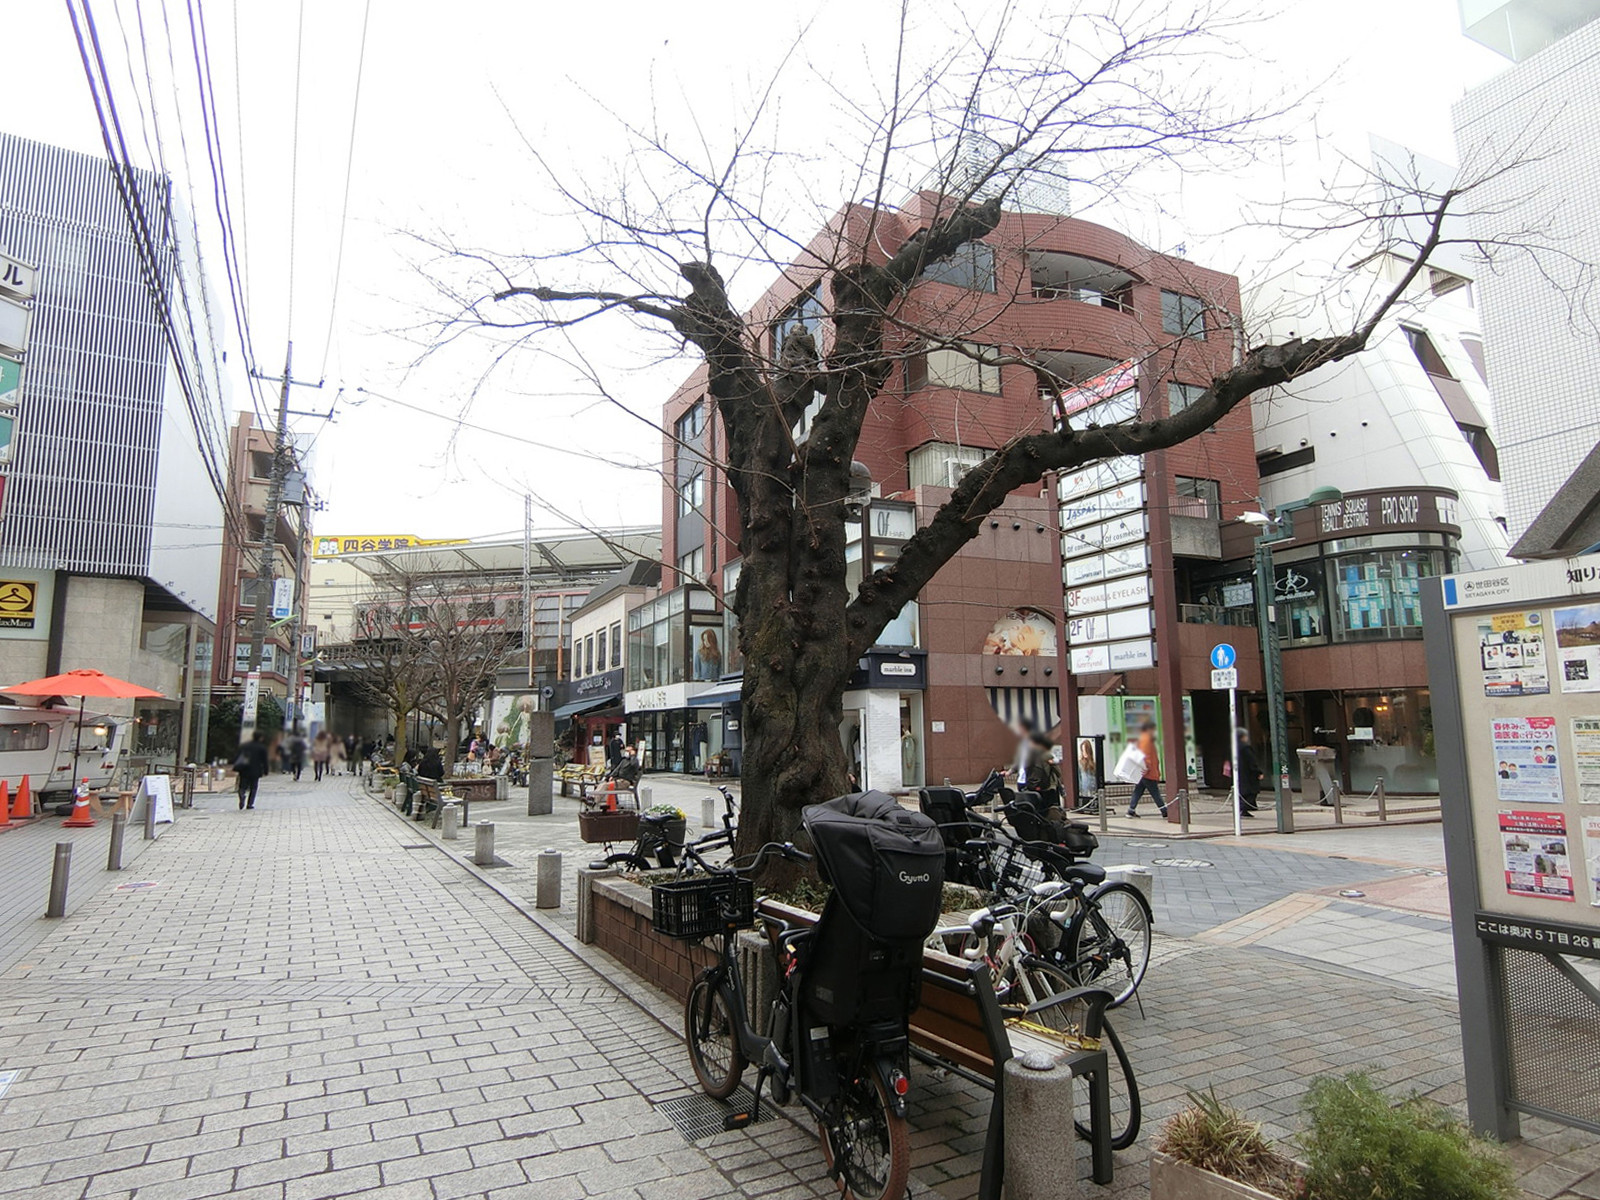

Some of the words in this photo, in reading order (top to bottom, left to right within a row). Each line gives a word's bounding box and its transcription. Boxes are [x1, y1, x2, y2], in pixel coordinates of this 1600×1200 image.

[1066, 504, 1097, 520] JASPAS
[1320, 502, 1342, 518] TENNIS
[1345, 498, 1368, 513] SQUASH
[1382, 498, 1398, 524] PRO
[1400, 496, 1418, 523] SHOP
[1113, 528, 1142, 541] cosmetics
[343, 538, 410, 551] 四谷学院
[1567, 567, 1600, 584] 知り
[1475, 577, 1509, 589] 世田谷区
[1068, 590, 1081, 607] 3F
[1112, 587, 1146, 600] EYELASH
[1465, 590, 1496, 599] SETAGAYA
[0, 618, 32, 627] axMara
[1070, 620, 1083, 637] 2F
[1114, 651, 1135, 661] marble
